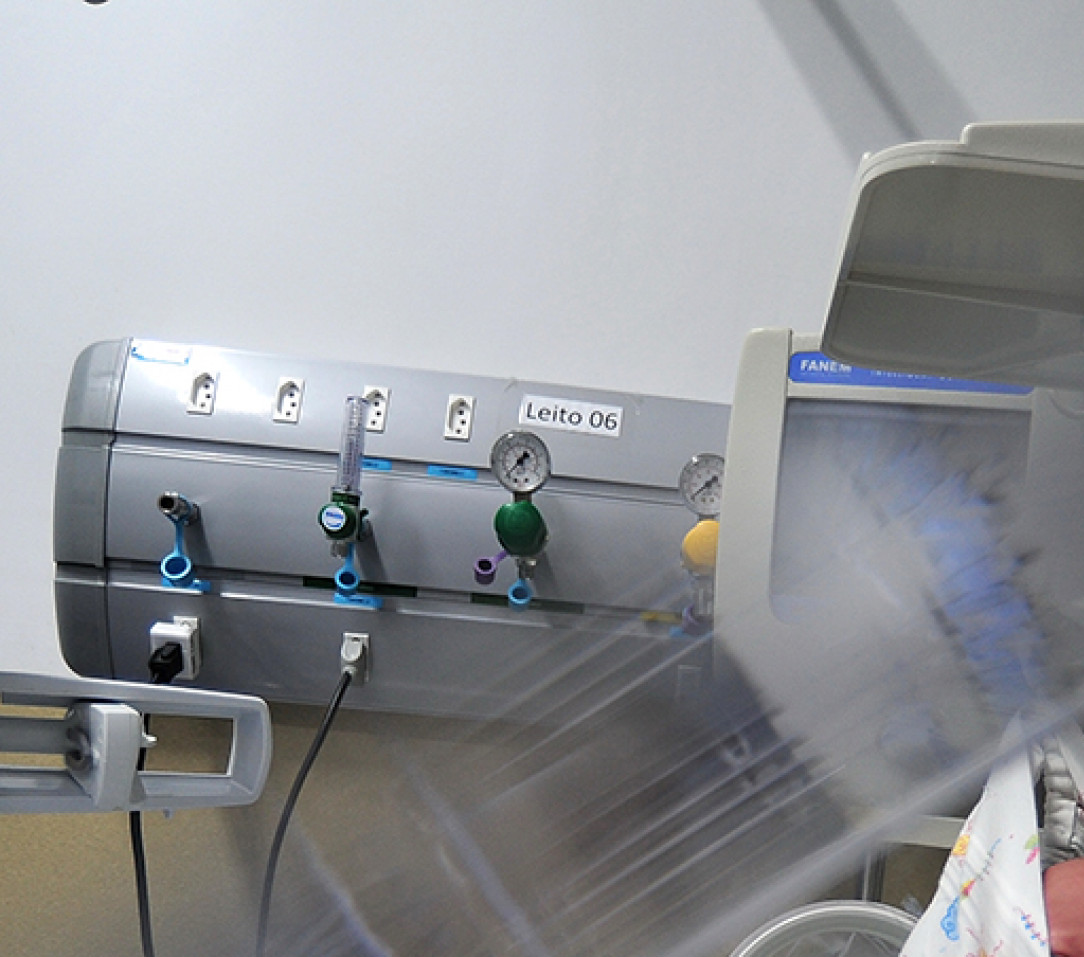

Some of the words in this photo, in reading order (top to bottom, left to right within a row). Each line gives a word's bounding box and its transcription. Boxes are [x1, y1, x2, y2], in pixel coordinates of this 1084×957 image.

[800, 360, 852, 373] FANEM
[526, 402, 583, 426] Leito
[589, 410, 618, 430] 06
